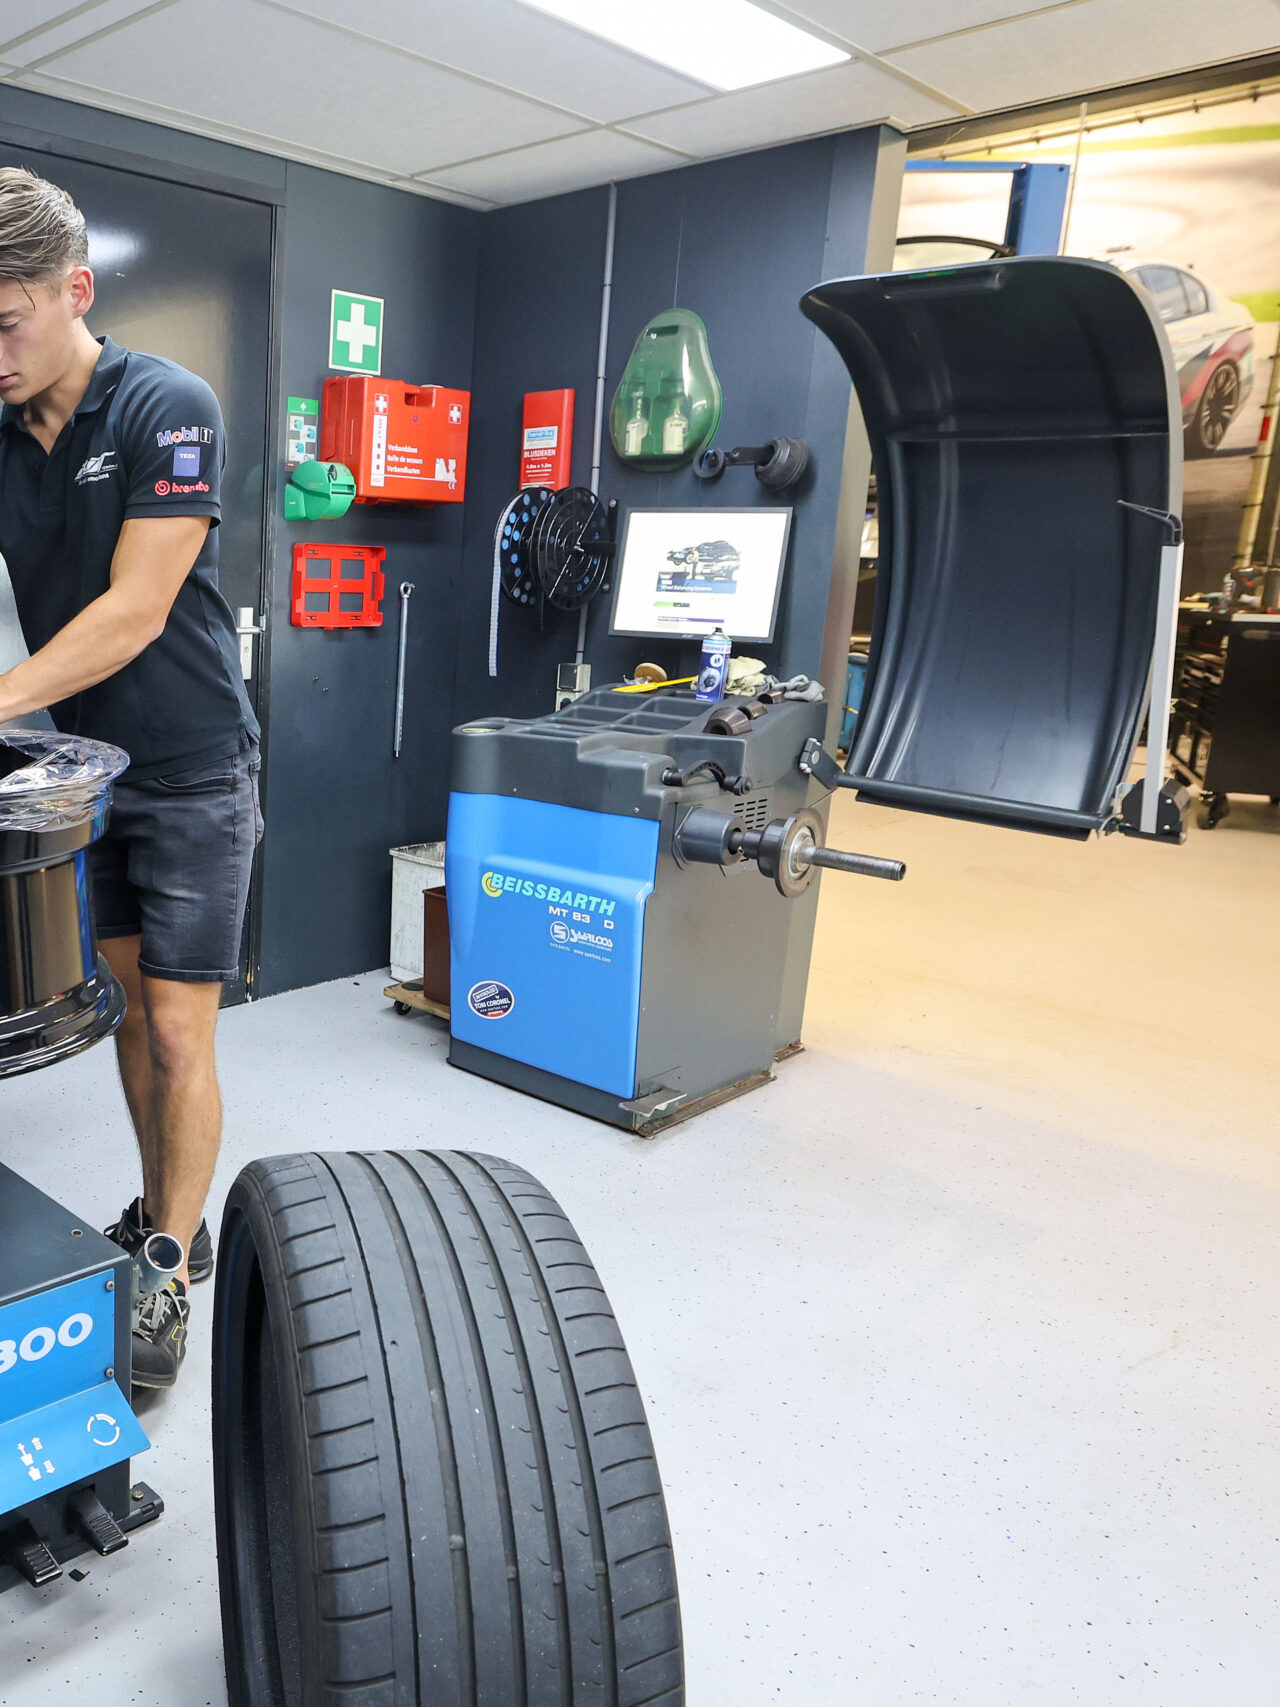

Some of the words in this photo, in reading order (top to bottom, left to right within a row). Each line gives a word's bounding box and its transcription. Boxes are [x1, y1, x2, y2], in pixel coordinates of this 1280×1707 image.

[156, 426, 199, 447] Mobil
[200, 427, 213, 443] 1
[524, 448, 556, 458] BLUSDEKEN
[172, 480, 210, 494] brembo
[490, 873, 616, 916] BEISSBARTH
[548, 905, 568, 918] MT
[572, 911, 591, 924] 83
[474, 1001, 487, 1009] TOM
[486, 998, 511, 1007] CORONEL
